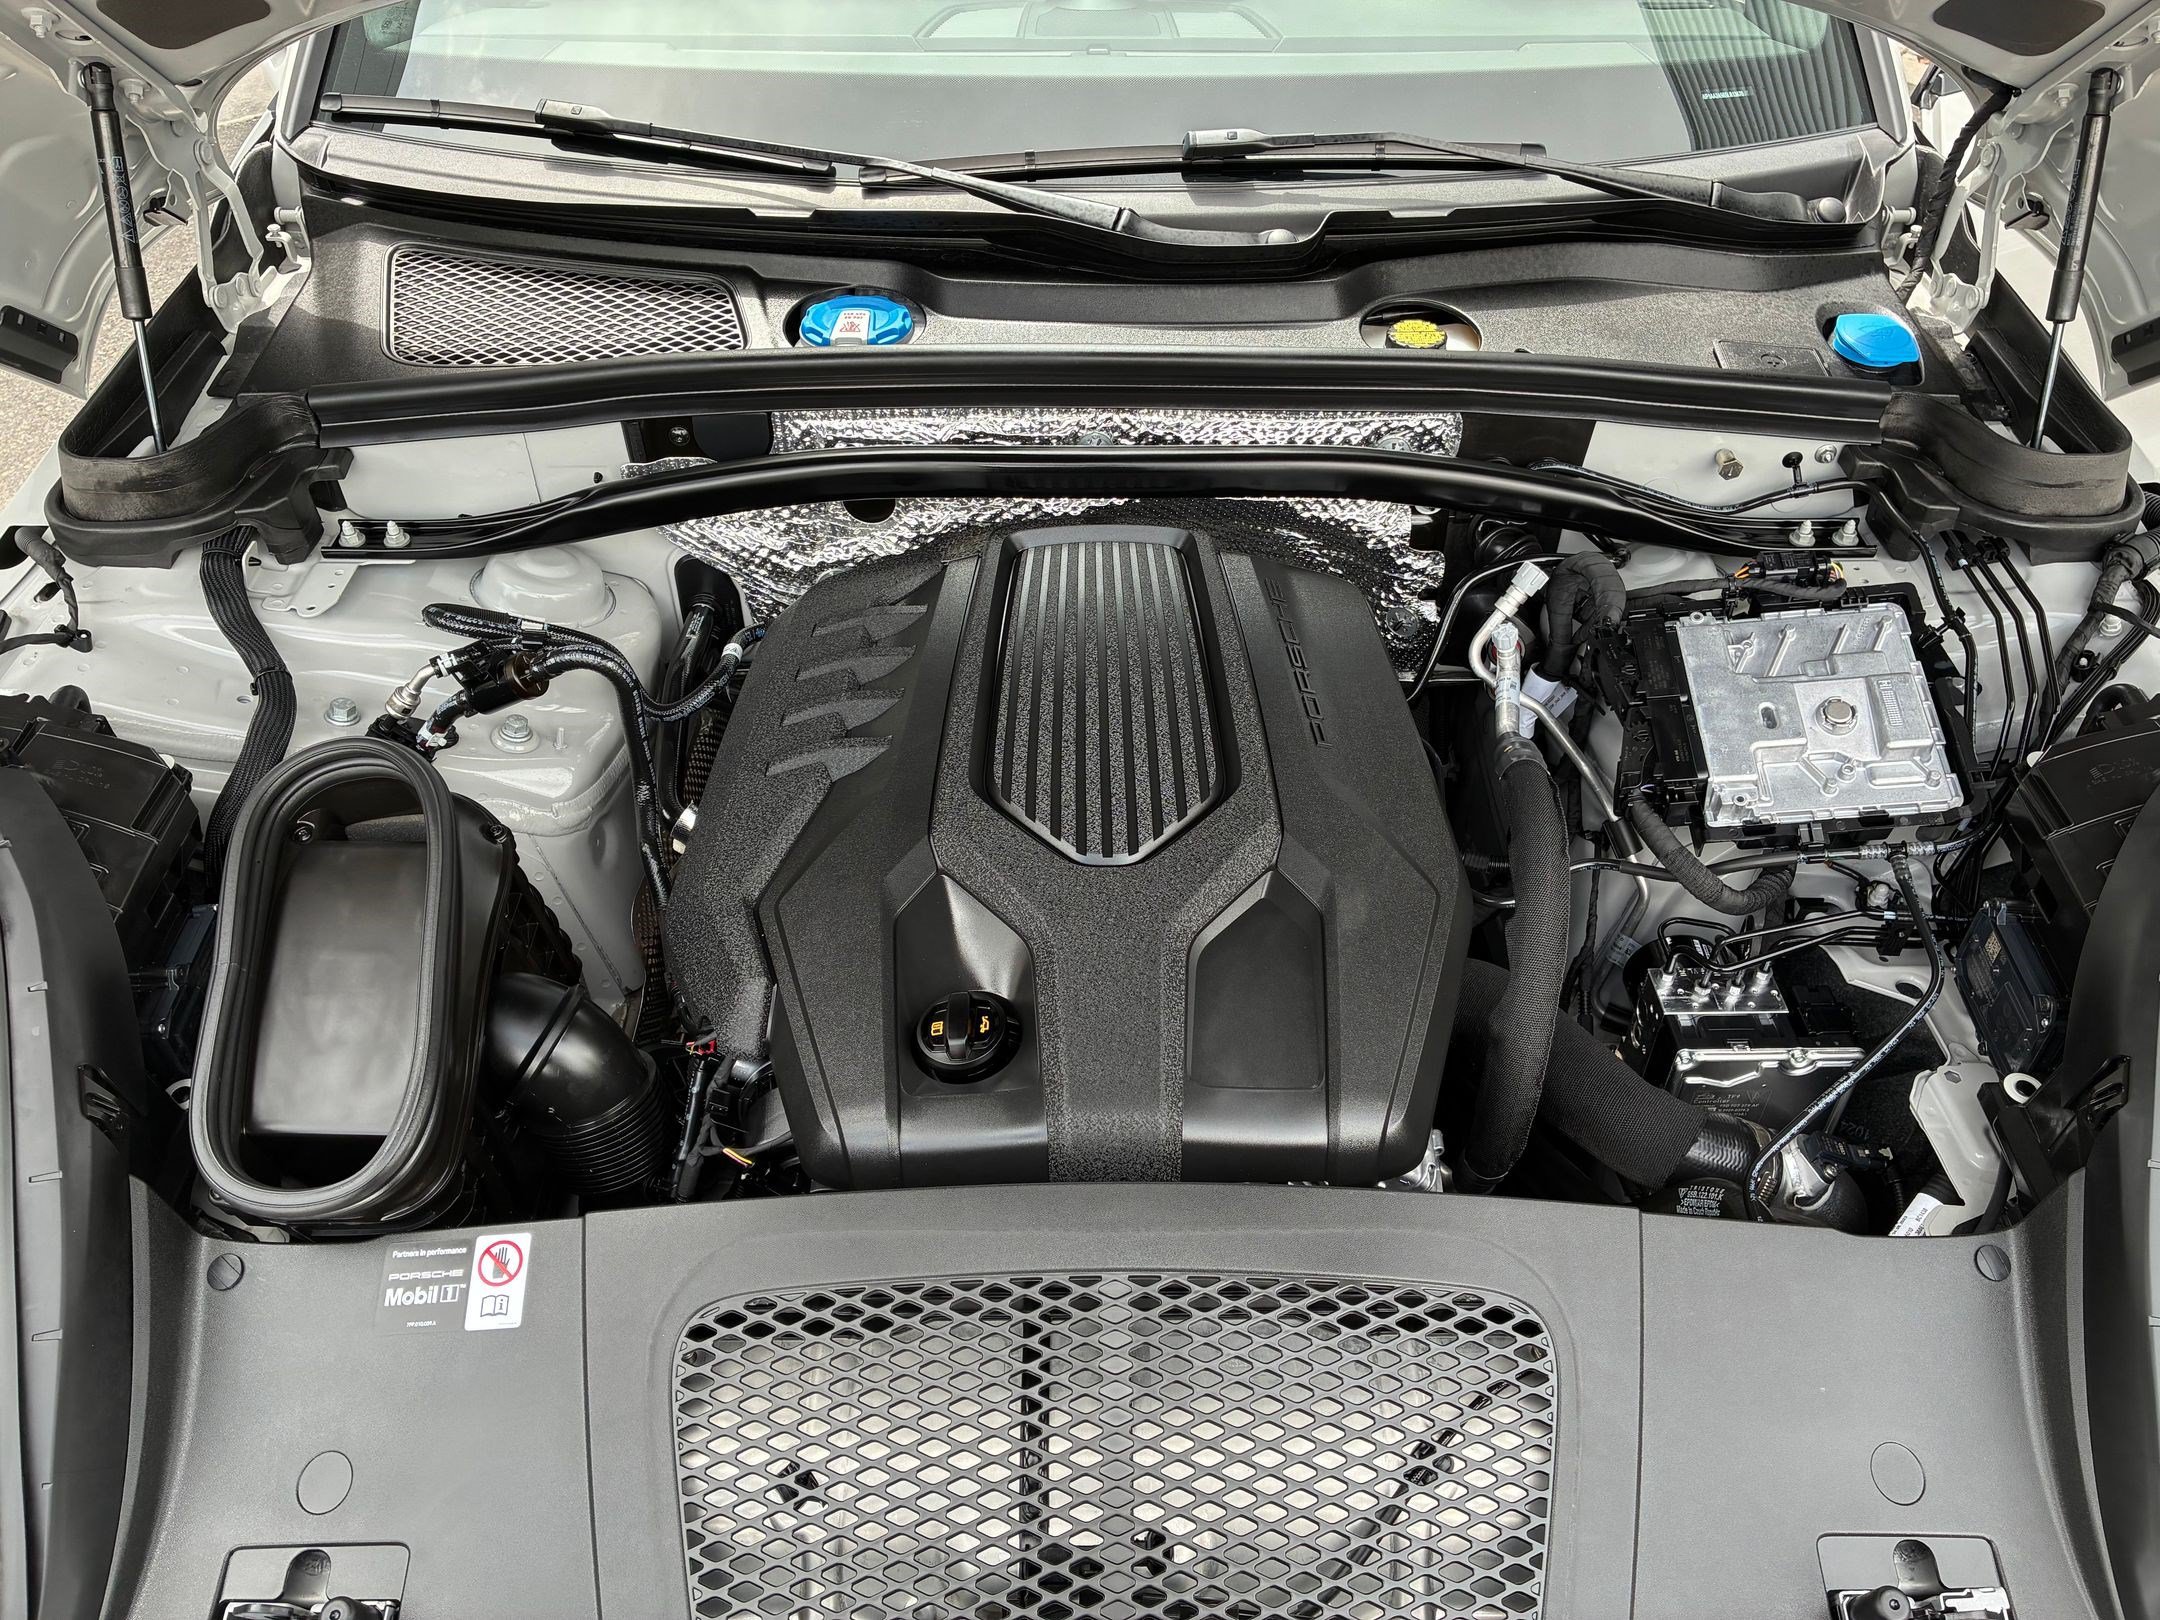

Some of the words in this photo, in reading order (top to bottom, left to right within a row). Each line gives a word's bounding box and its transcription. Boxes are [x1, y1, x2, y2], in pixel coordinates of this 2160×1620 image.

[1264, 577, 1334, 749] PORSCHE
[392, 1248, 420, 1259] Partners
[420, 1248, 426, 1257] in
[427, 1247, 467, 1257] performance
[388, 1269, 464, 1281] PORSCHE
[384, 1284, 438, 1307] Mobil
